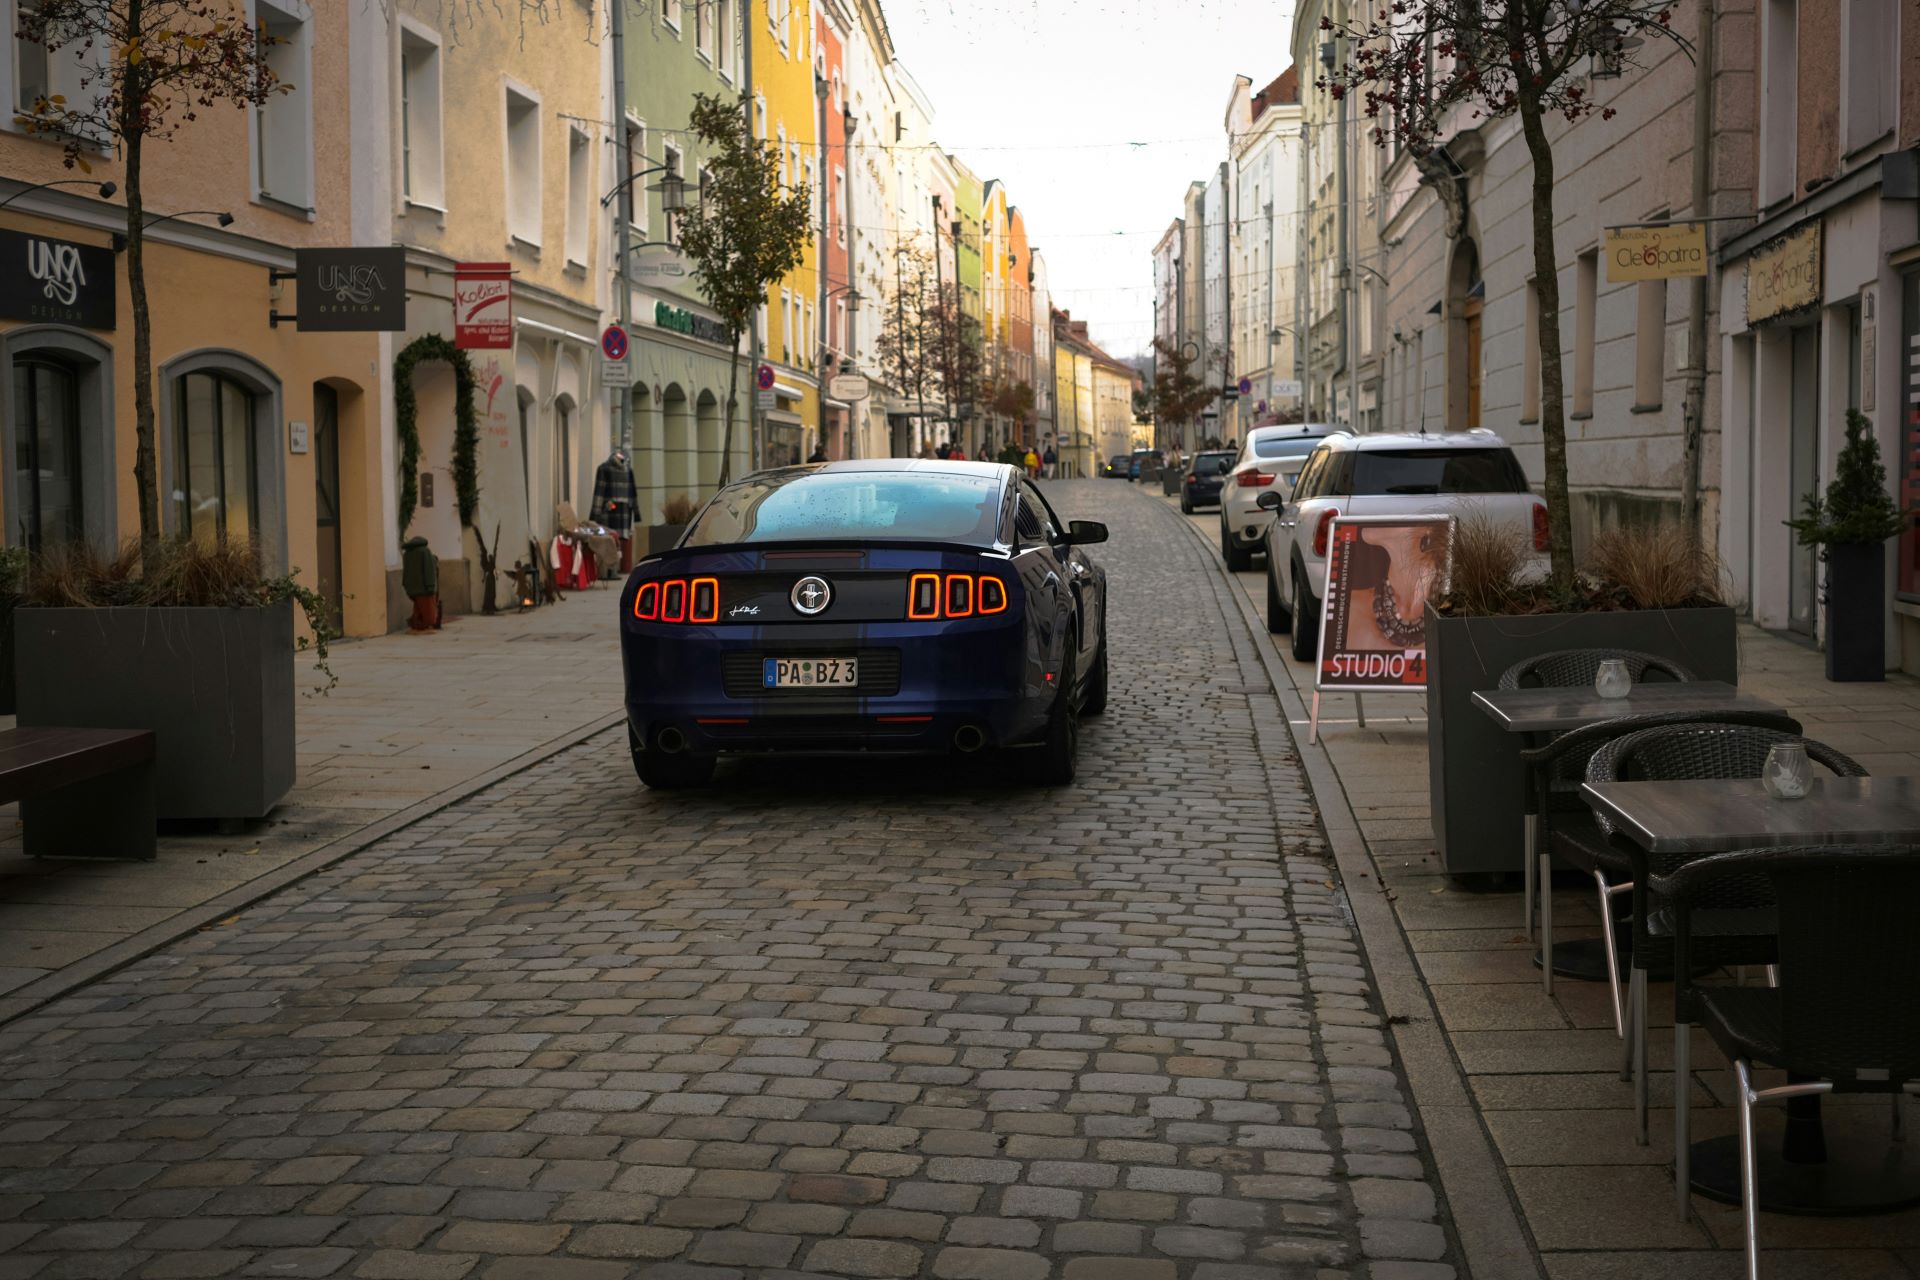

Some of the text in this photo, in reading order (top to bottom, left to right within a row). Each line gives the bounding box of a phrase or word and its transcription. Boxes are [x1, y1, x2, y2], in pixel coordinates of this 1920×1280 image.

[1616, 242, 1701, 270] Cleopatra
[457, 282, 503, 306] Kolibri
[31, 304, 82, 320] DESIGN
[319, 305, 381, 313] DESIGN
[1335, 532, 1351, 650] DESIGNSCHMUCK KUNSTHANDWERK
[777, 663, 800, 683] PA
[1331, 652, 1423, 678] STUDIO 4
